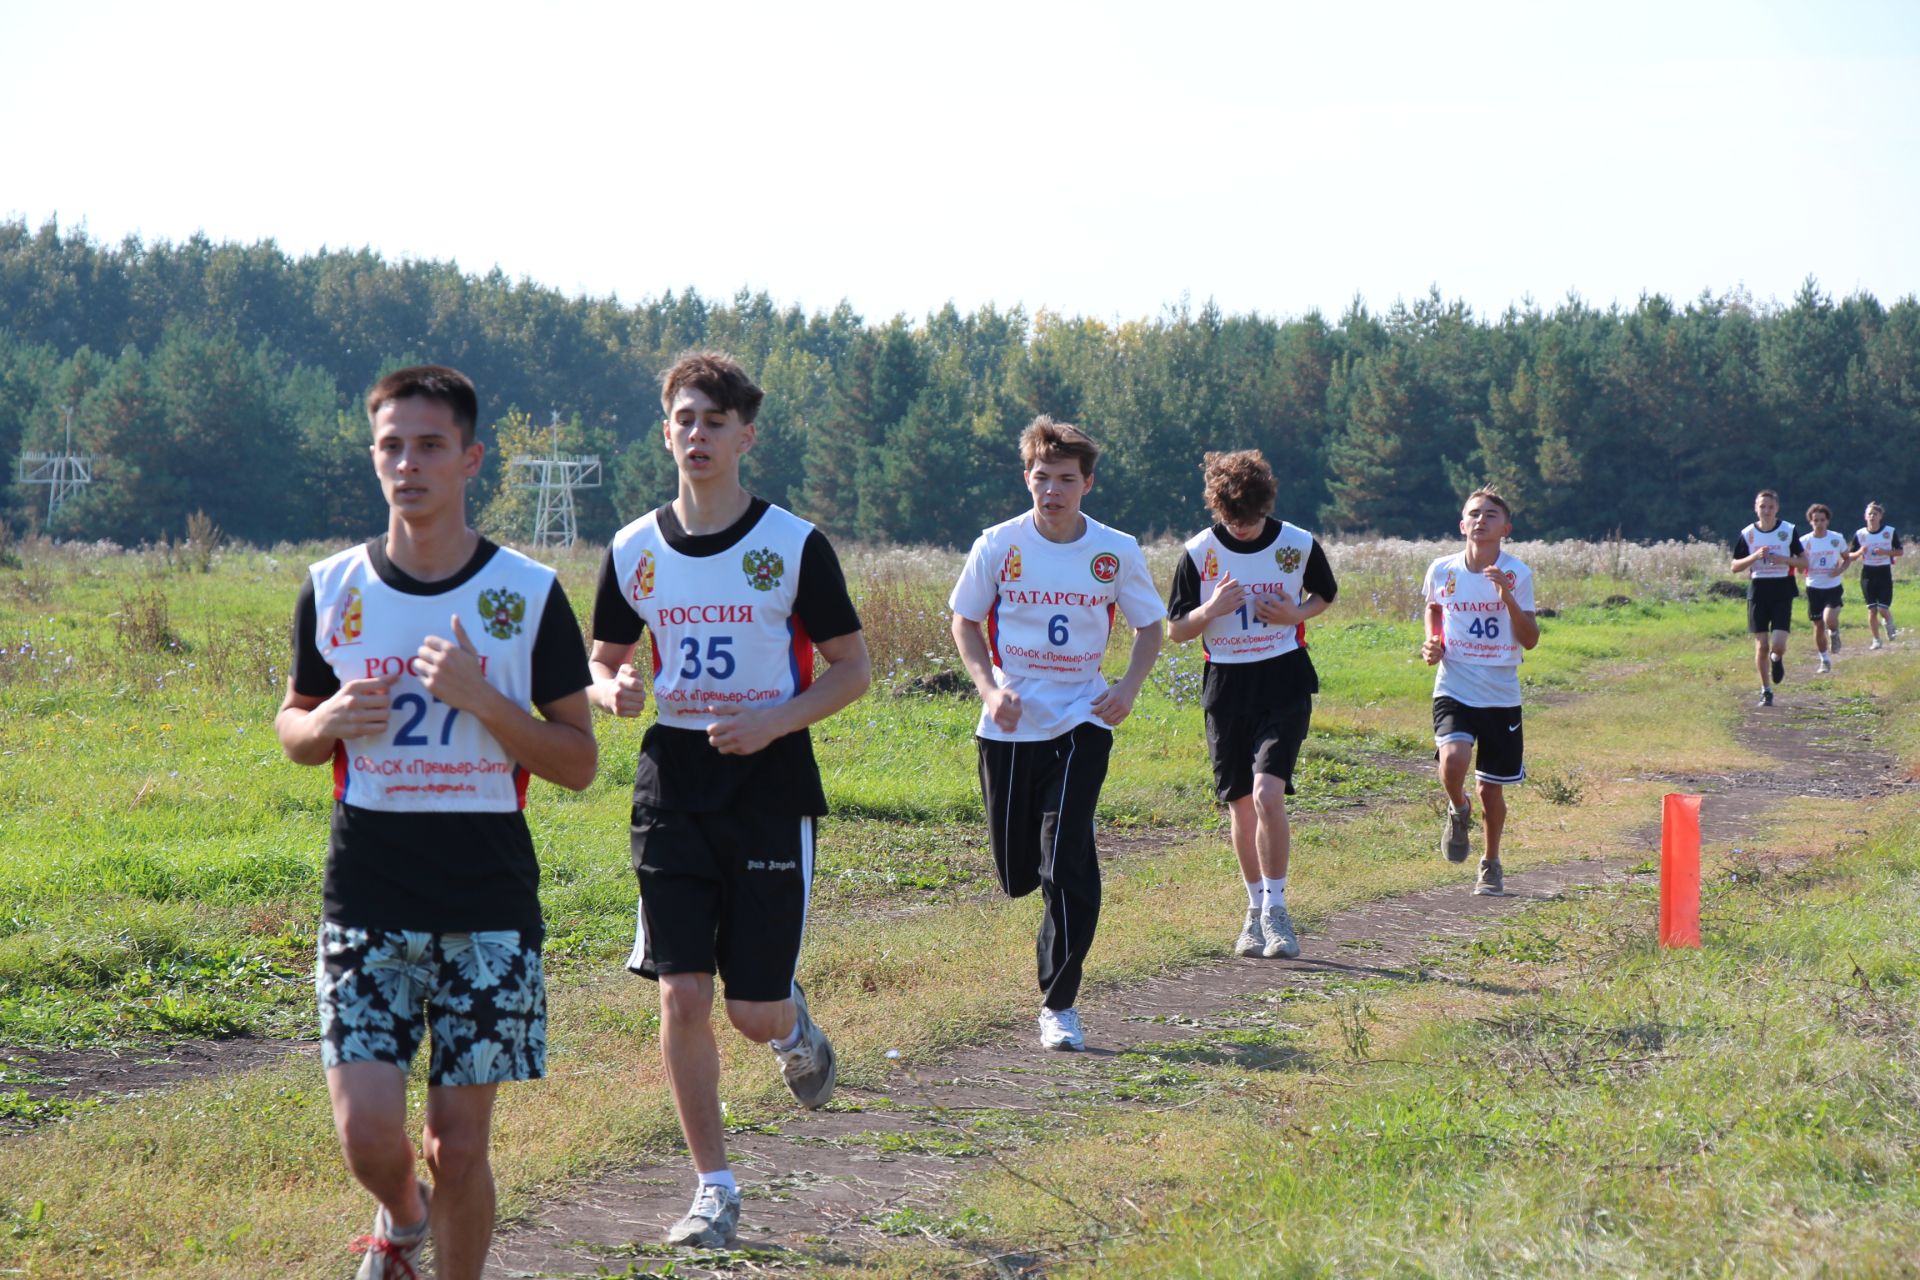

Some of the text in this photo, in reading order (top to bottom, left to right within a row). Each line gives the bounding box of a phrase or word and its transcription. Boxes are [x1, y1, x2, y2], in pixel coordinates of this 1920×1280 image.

[1243, 582, 1283, 595] ССИЯ
[658, 605, 753, 626] РОССИЯ
[1469, 617, 1499, 639] 46
[1048, 614, 1069, 647] 6
[680, 636, 736, 680] 35
[391, 693, 461, 746] 27
